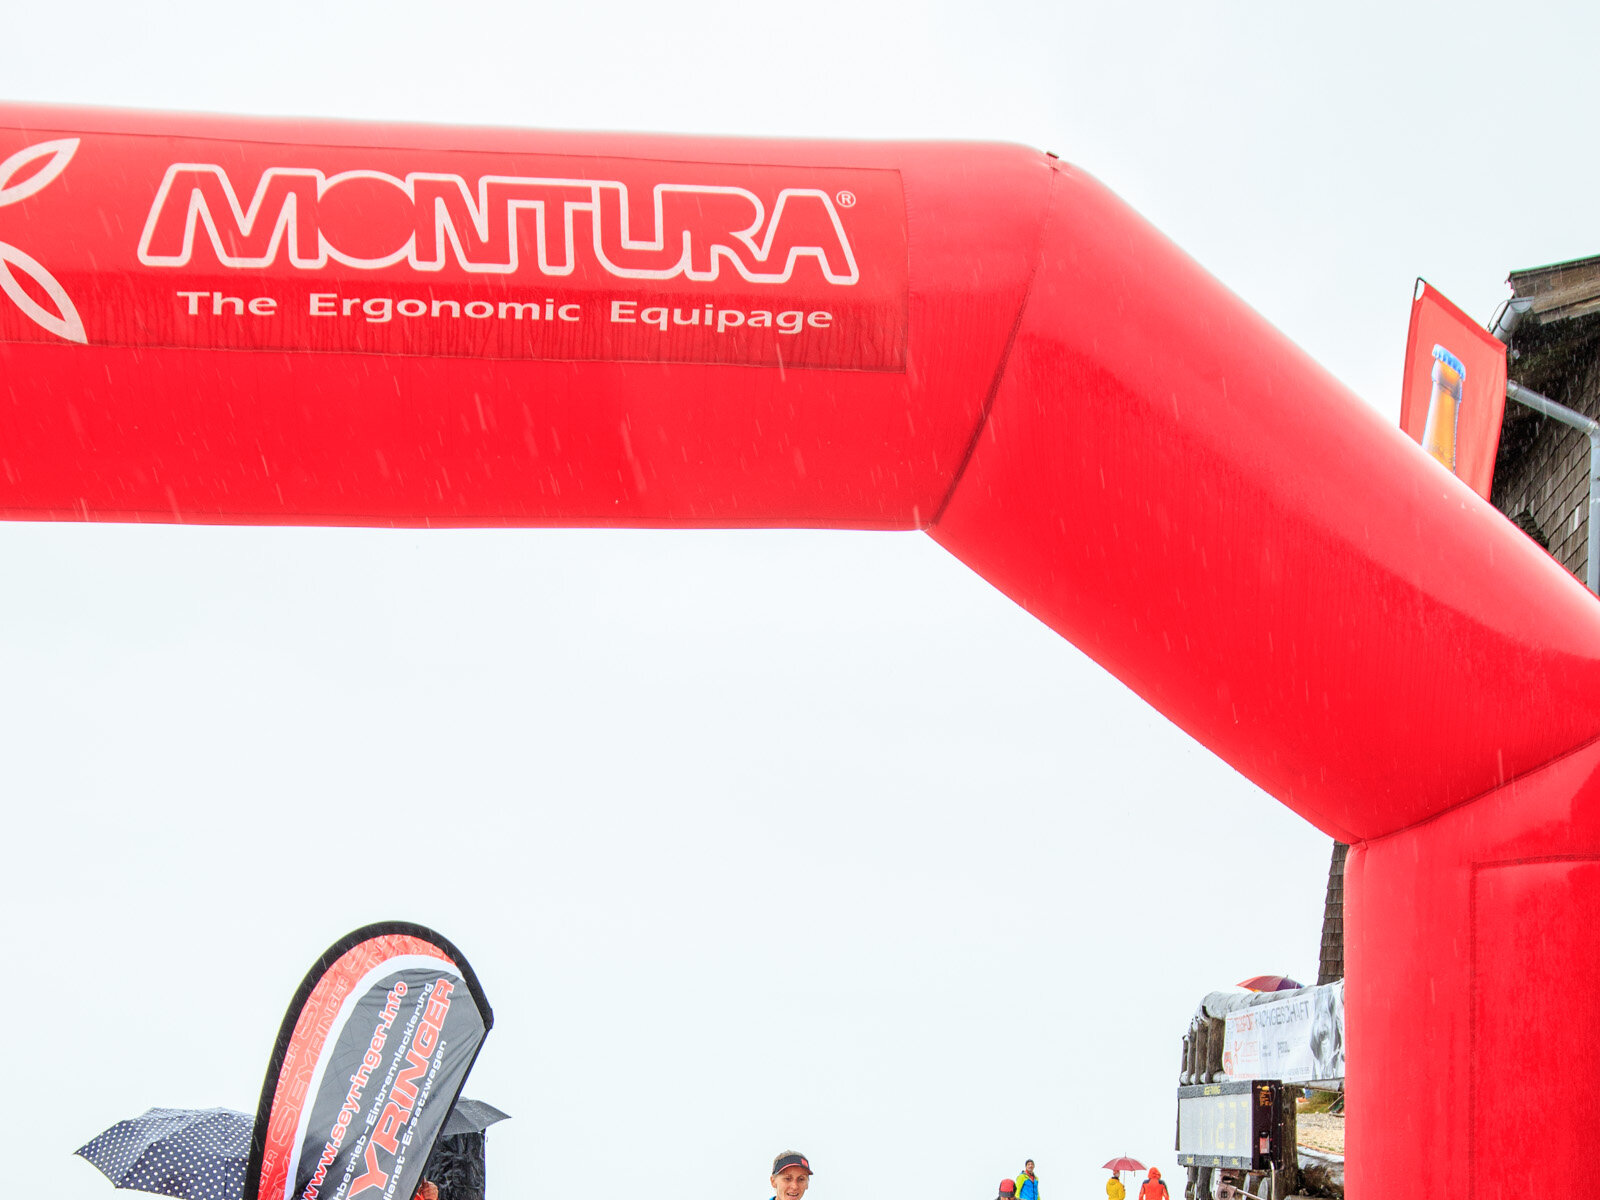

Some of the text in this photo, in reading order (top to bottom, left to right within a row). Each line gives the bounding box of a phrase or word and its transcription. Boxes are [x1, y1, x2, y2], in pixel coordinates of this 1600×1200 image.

[176, 291, 833, 334] The Ergonomic Equipage
